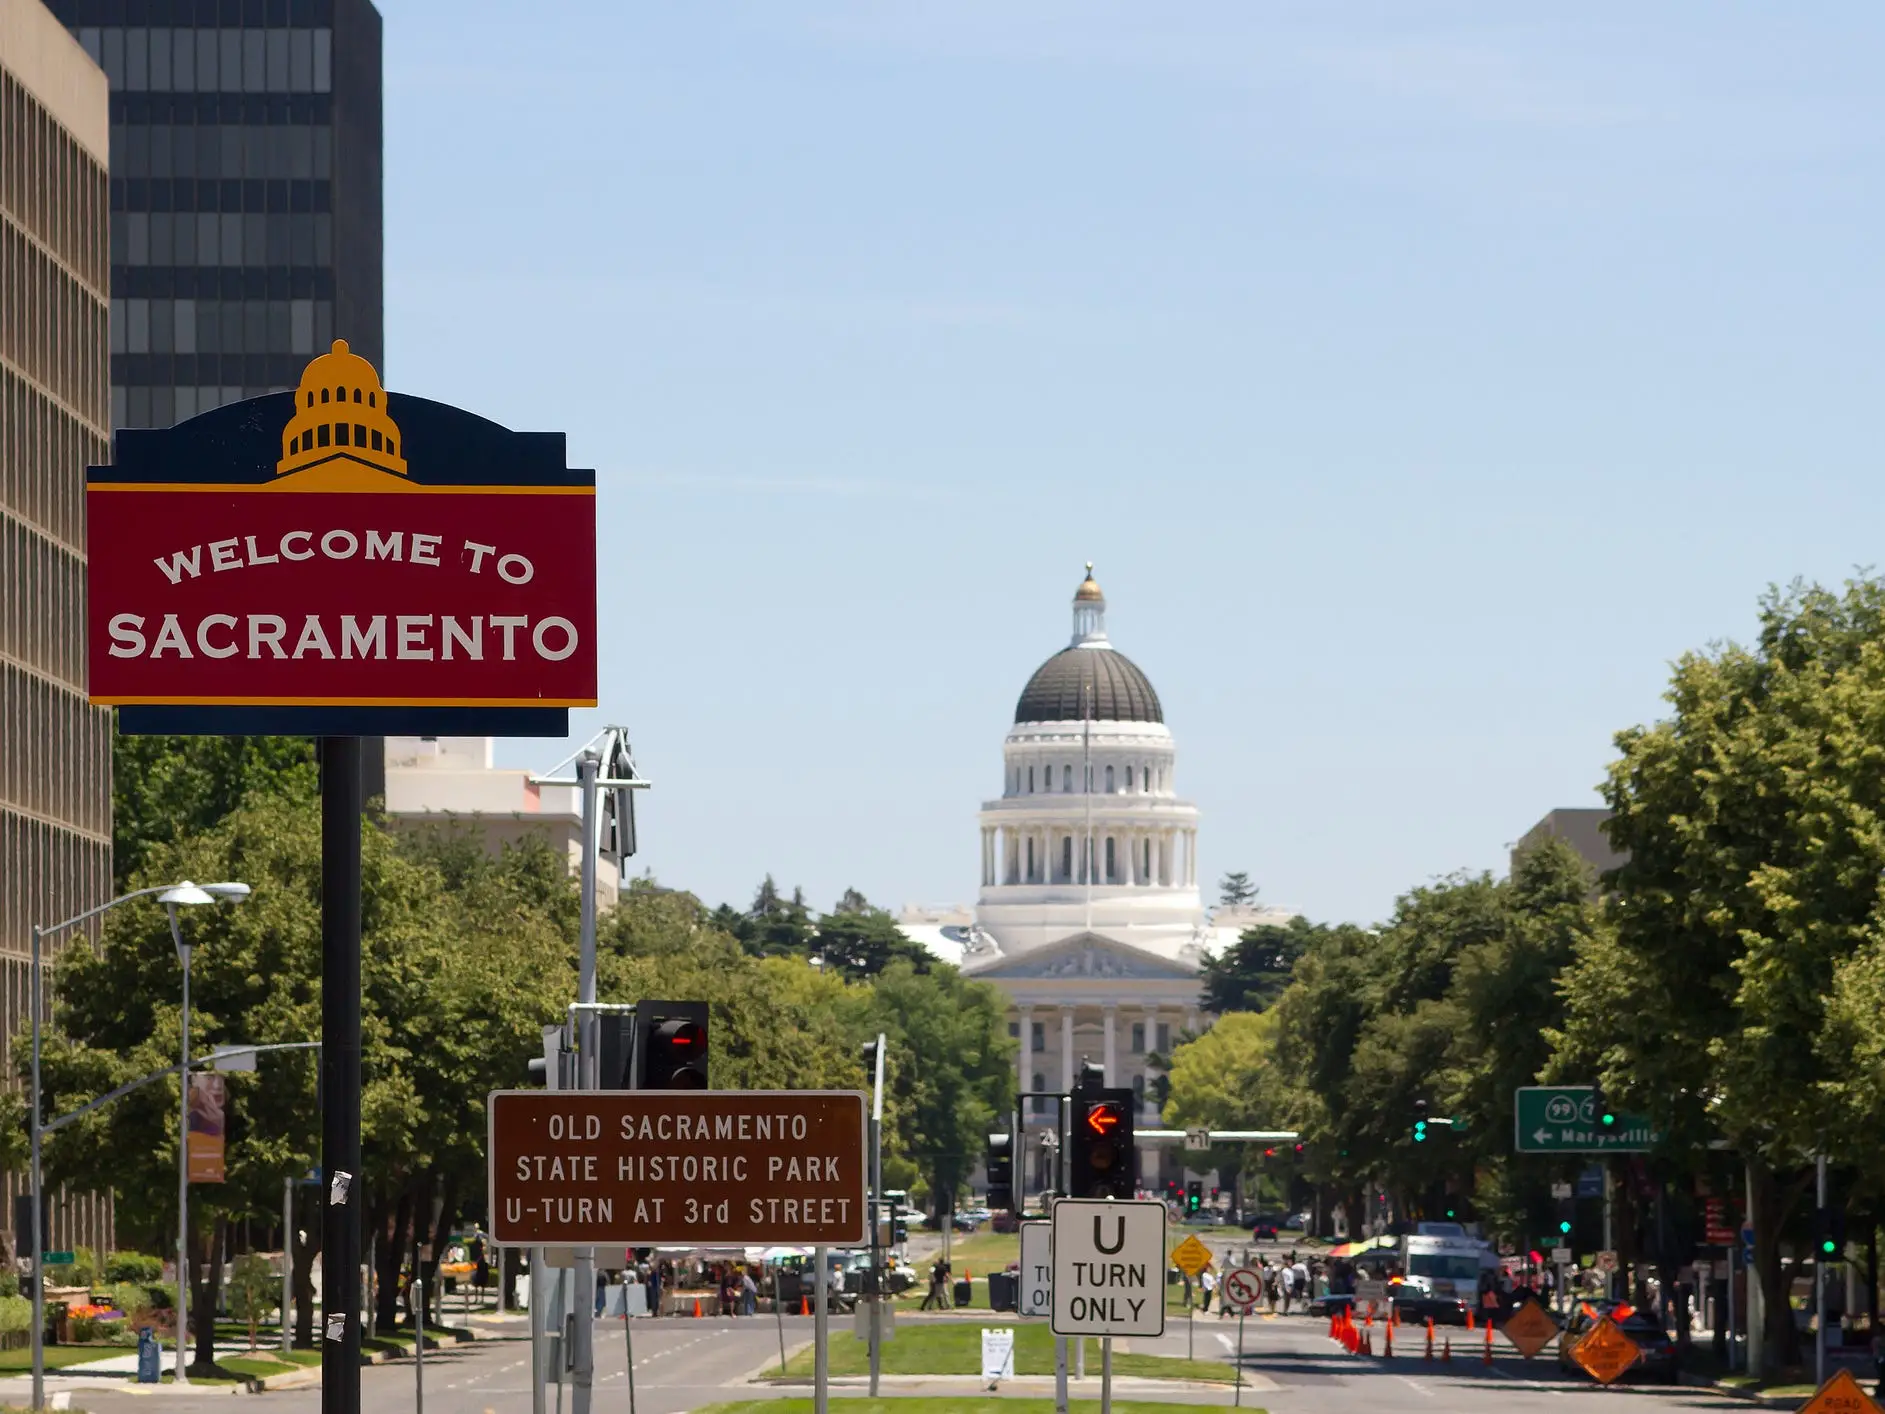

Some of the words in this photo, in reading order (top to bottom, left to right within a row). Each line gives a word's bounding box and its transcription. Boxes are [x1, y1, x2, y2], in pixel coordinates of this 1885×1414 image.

[154, 530, 442, 585] WELCOME
[463, 539, 535, 585] TO
[108, 613, 579, 662] SACRAMENTO
[1552, 1103, 1571, 1116] 99
[1585, 1103, 1595, 1116] 7
[548, 1114, 601, 1140] OLD
[620, 1114, 807, 1141] SACRAMENTO
[1561, 1128, 1660, 1147] Marysville
[516, 1156, 598, 1181] STATE
[618, 1156, 748, 1181] HISTORIC
[768, 1156, 840, 1182] PARK
[506, 1198, 613, 1224] U-TURN
[633, 1198, 665, 1223] AT
[684, 1198, 729, 1224] 3rd
[749, 1198, 851, 1224] STREET
[1093, 1215, 1126, 1255] U
[1072, 1262, 1146, 1288] TURN
[1070, 1296, 1146, 1323] ONLY
